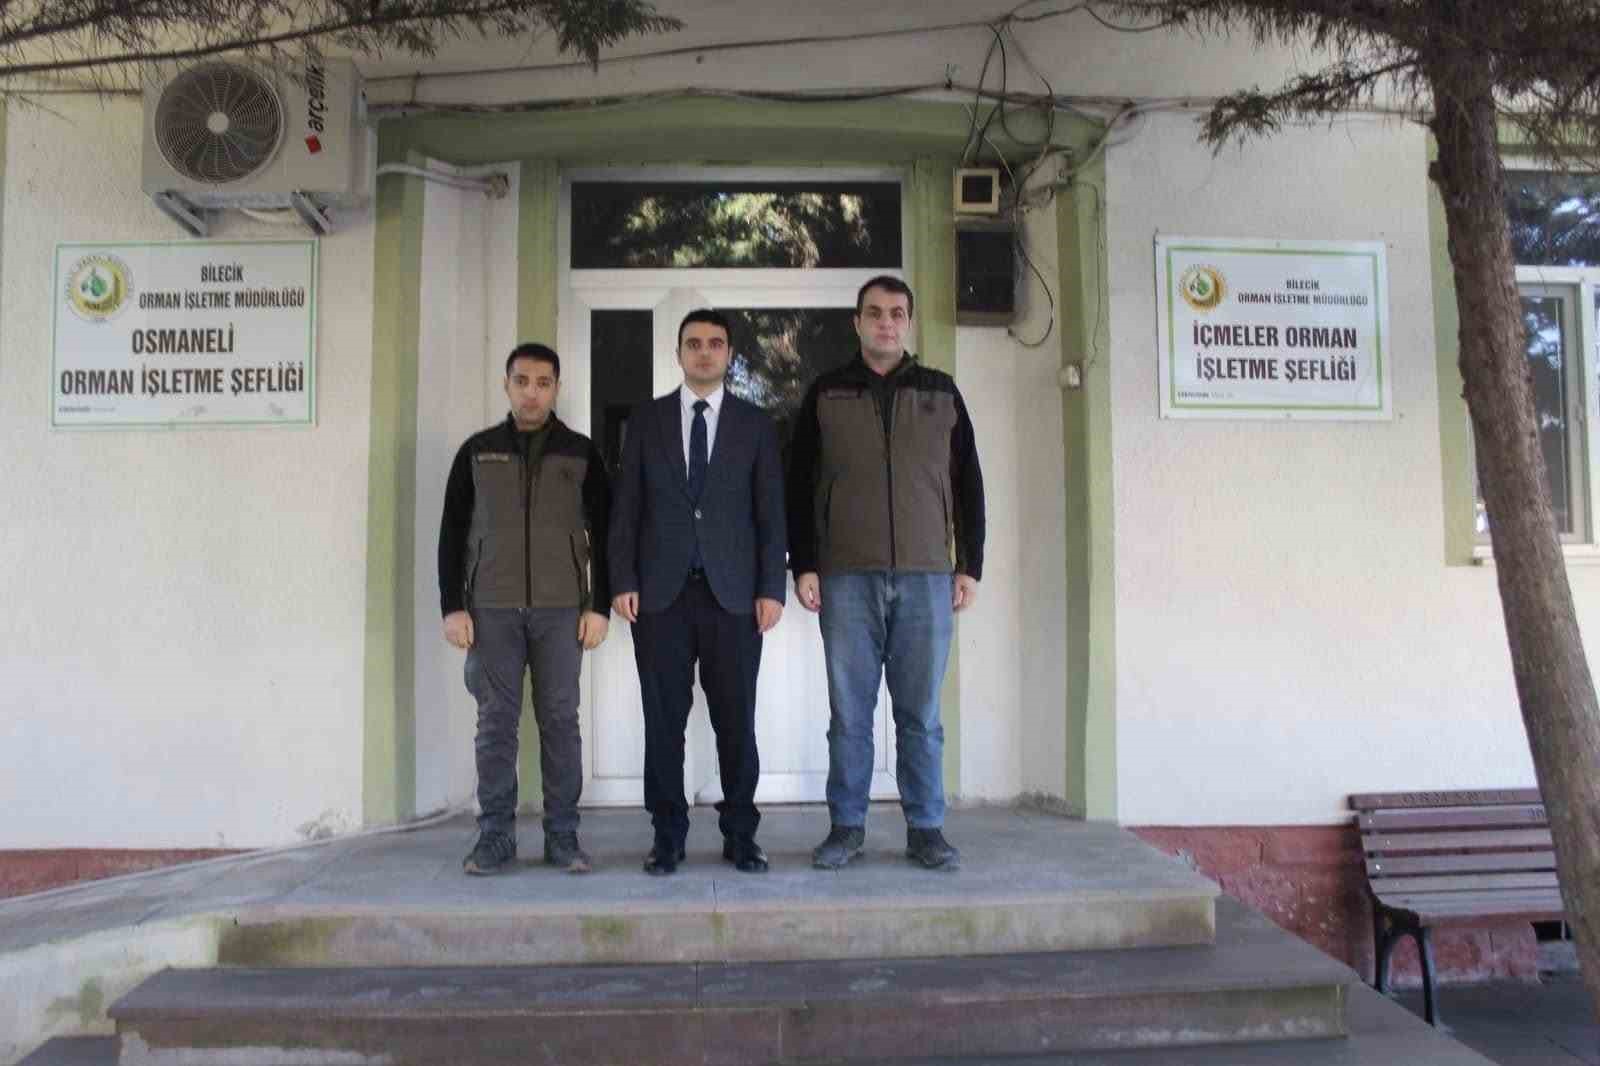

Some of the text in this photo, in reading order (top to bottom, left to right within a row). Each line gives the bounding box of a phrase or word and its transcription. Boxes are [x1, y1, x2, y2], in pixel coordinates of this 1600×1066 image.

[201, 262, 244, 282] BİLECİK
[139, 288, 304, 310] ORMAN İŞLETME MÜDÜRLÜĞÜ
[1238, 293, 1271, 304] ORMAN
[131, 323, 234, 354] OSMANELİ
[1193, 320, 1357, 348] İÇMELER ORMAN
[60, 361, 304, 396] ORMAN İŞLETME ŞEFLİĞİ
[1196, 353, 1356, 382] İŞLETME ŞEFLİĞİ
